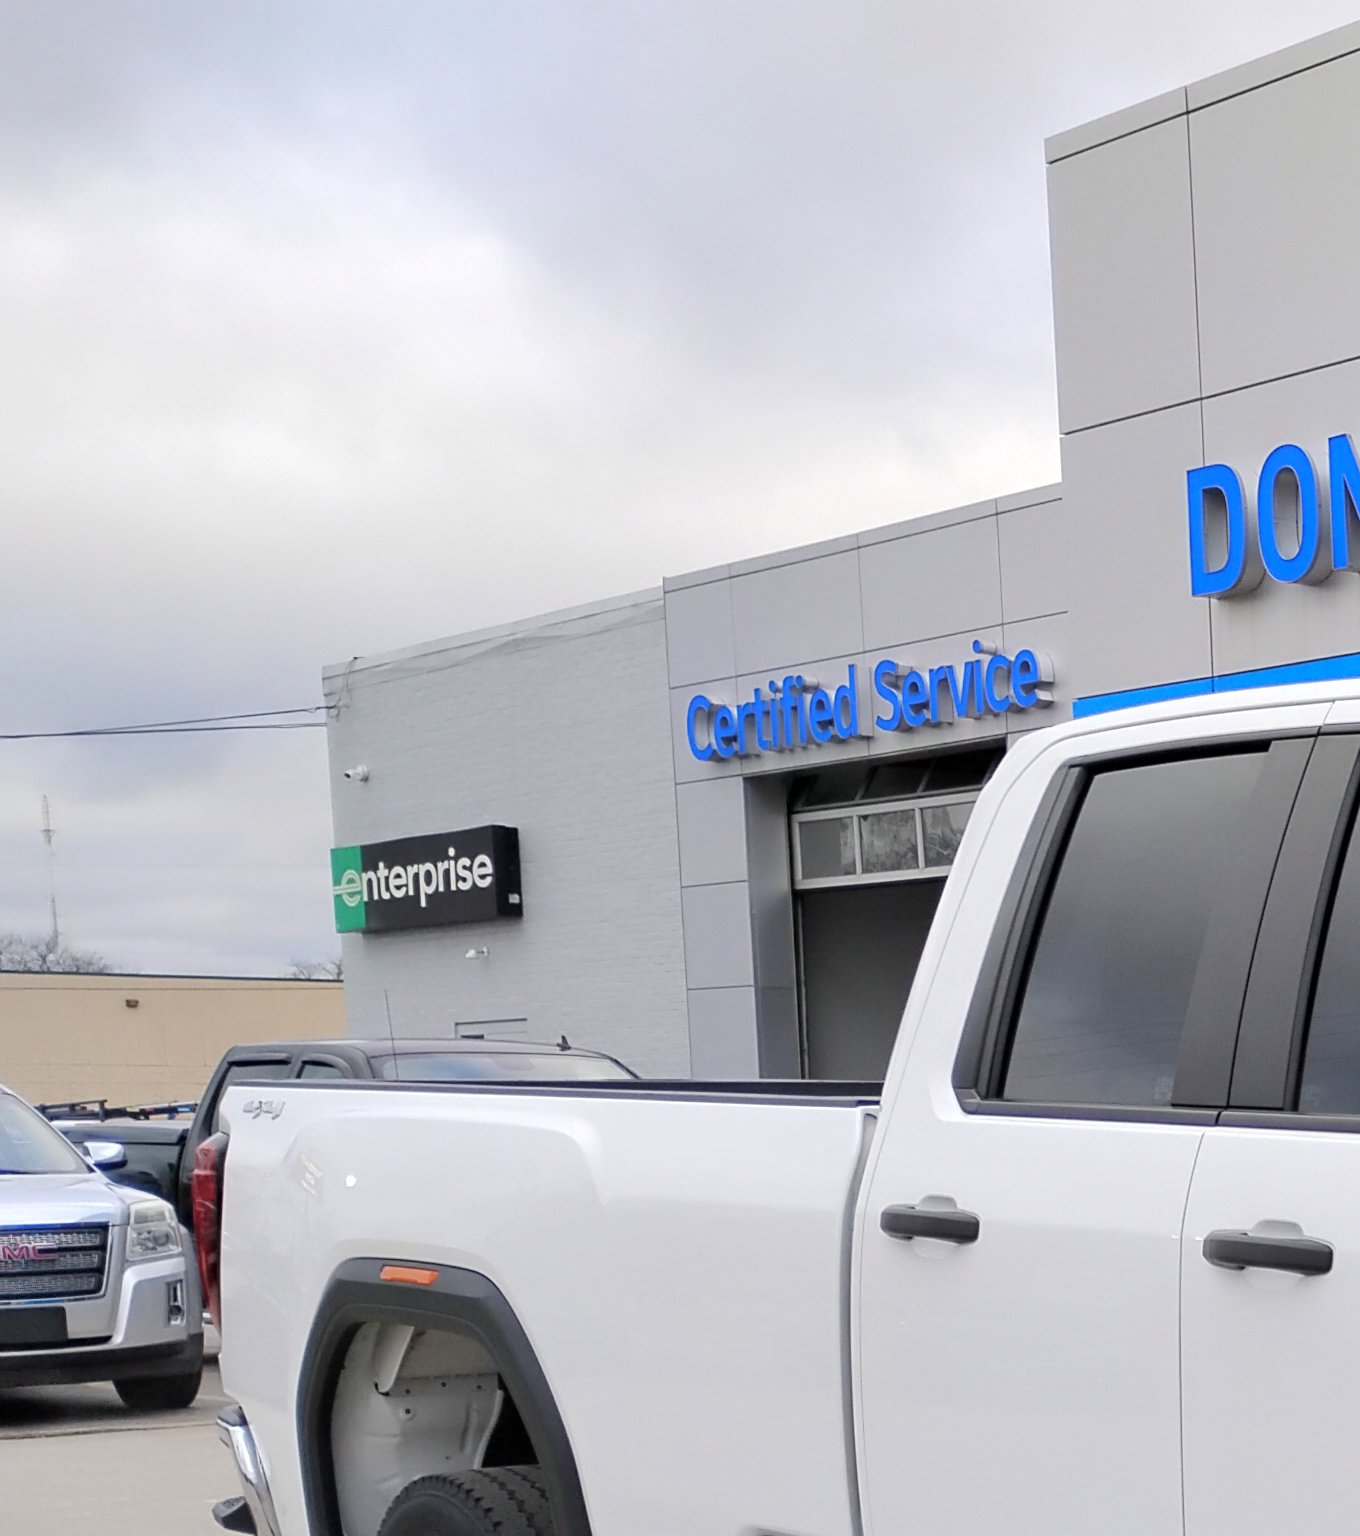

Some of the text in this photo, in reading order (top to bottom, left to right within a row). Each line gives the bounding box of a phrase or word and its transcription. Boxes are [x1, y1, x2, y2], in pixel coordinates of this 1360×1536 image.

[687, 639, 1039, 761] Certified Service
[334, 847, 493, 907] enterprise
[0, 1242, 58, 1261] MC
